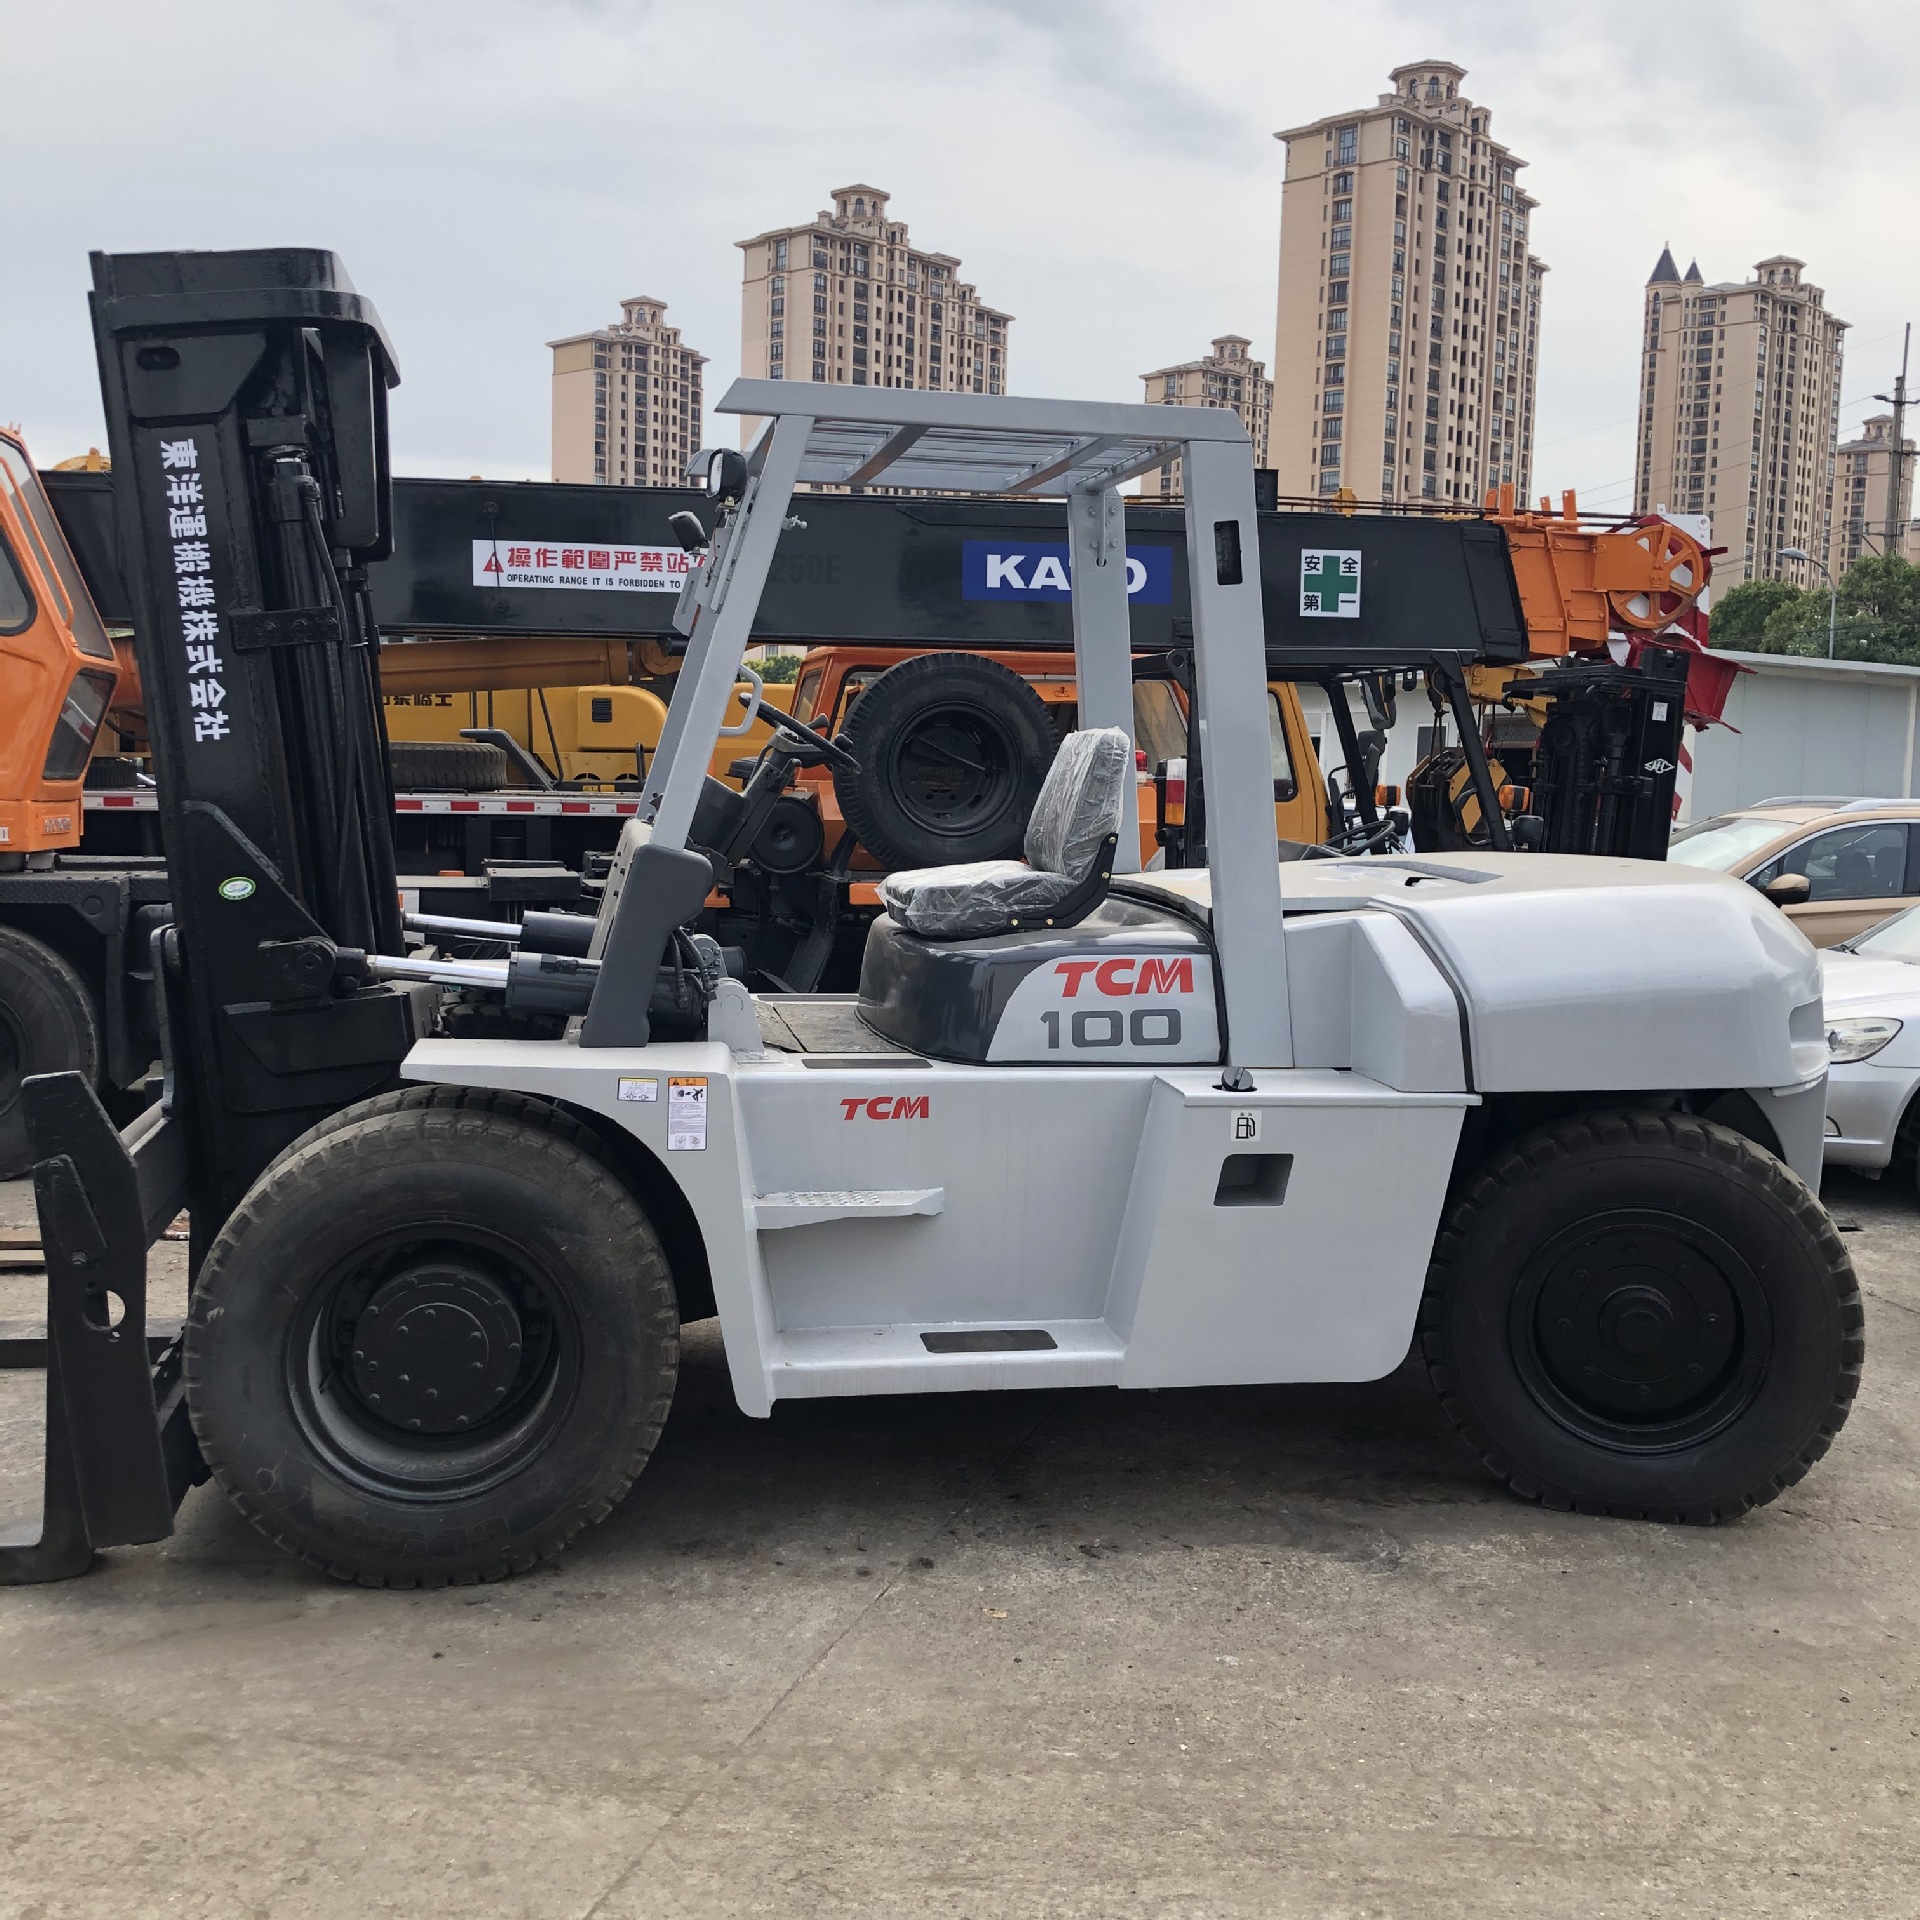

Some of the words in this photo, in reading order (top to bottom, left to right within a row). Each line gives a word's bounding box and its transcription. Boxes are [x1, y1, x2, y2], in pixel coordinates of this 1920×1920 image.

[986, 554, 1148, 594] KAO
[1304, 555, 1358, 573] 安全
[507, 574, 554, 583] OPERATING
[560, 576, 588, 585] RANGE
[592, 577, 600, 586] IT
[605, 578, 613, 586] IS
[619, 578, 665, 588] FORBIDDEN
[670, 580, 681, 589] TO
[1303, 594, 1356, 611] 第一
[1054, 958, 1194, 998] TCM
[1040, 1008, 1182, 1049] 100
[840, 1096, 929, 1121] TCM
